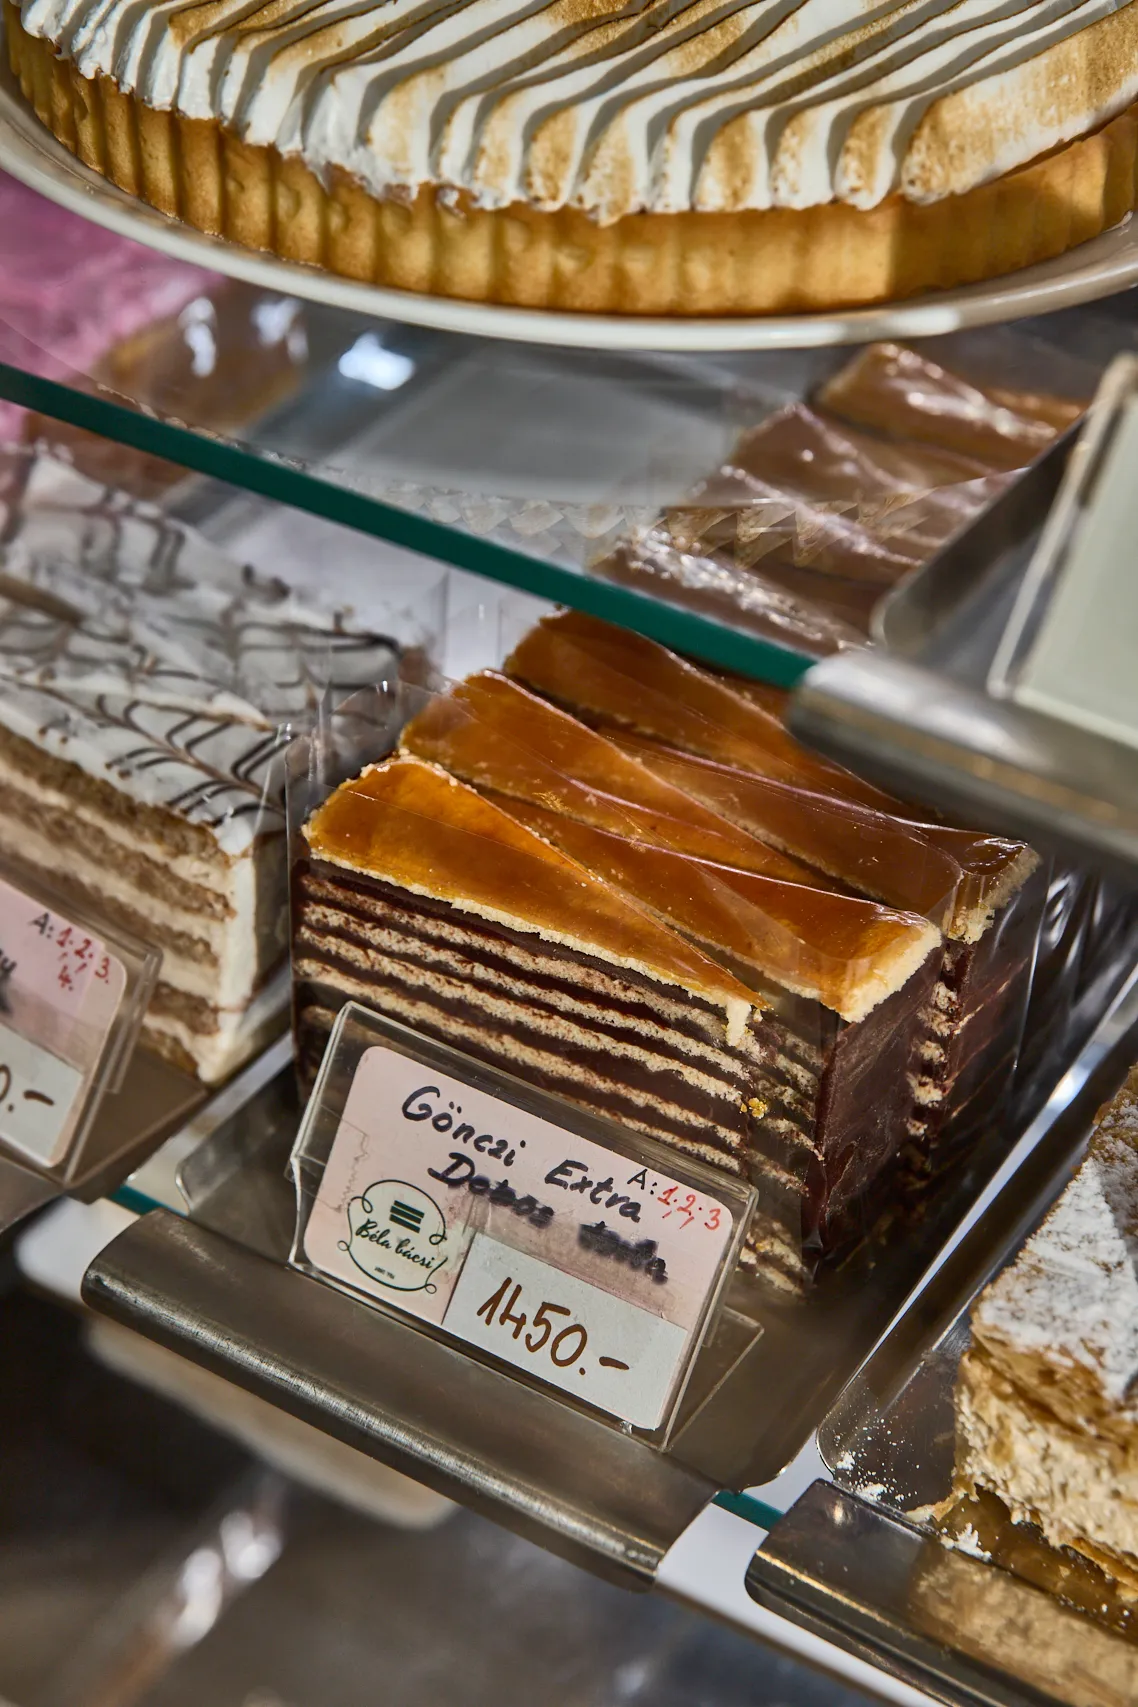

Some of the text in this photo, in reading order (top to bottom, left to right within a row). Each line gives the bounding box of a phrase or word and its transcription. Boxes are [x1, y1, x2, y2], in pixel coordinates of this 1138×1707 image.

[402, 1086, 641, 1223] Gönczi Extra
[355, 1218, 435, 1269] Béla bácsi
